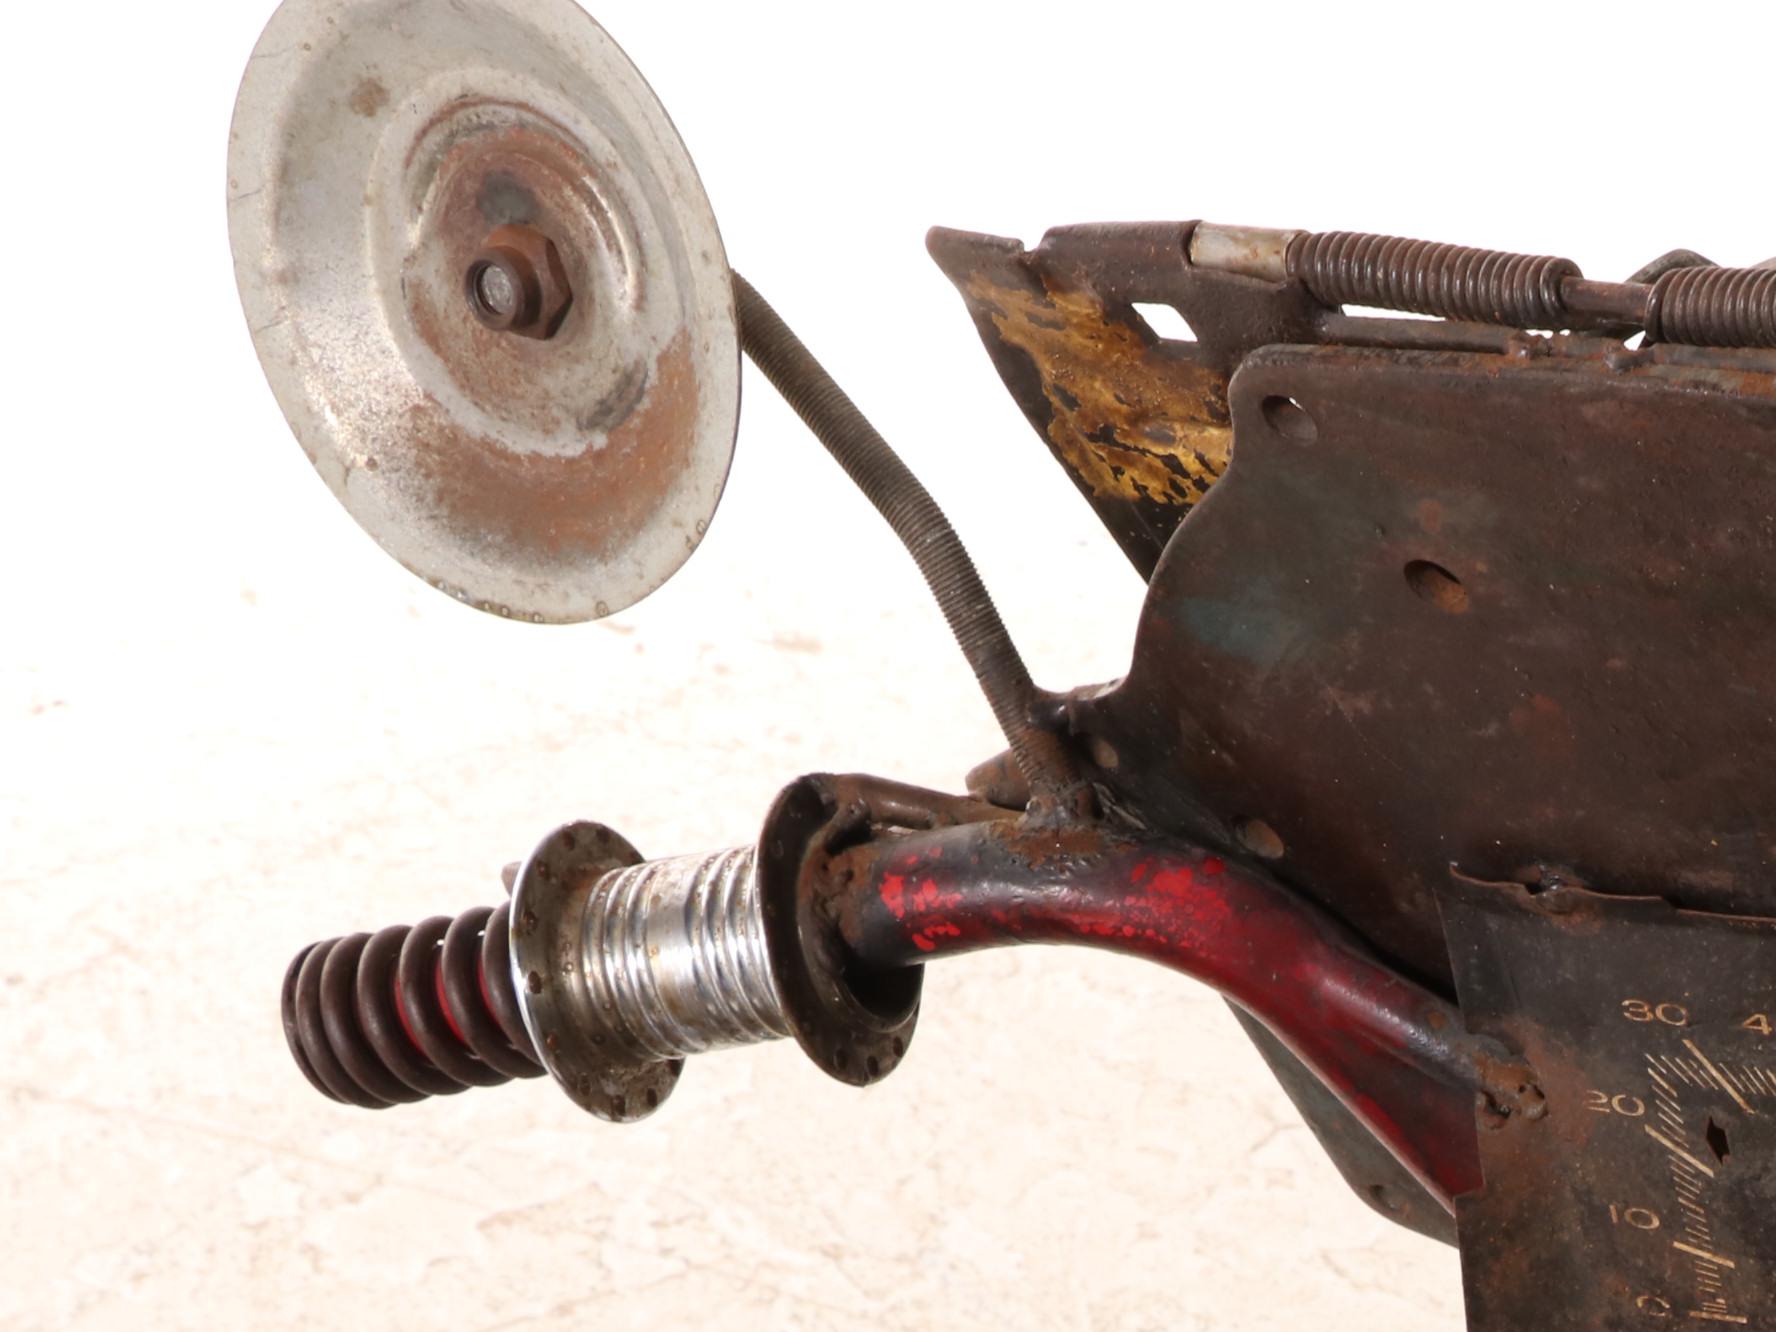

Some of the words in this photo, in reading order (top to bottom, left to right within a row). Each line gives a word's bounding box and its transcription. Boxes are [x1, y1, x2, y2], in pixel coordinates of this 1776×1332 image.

[1621, 1000, 1688, 1027] 30
[1586, 1090, 1646, 1117] 20
[1609, 1203, 1661, 1230] 10
